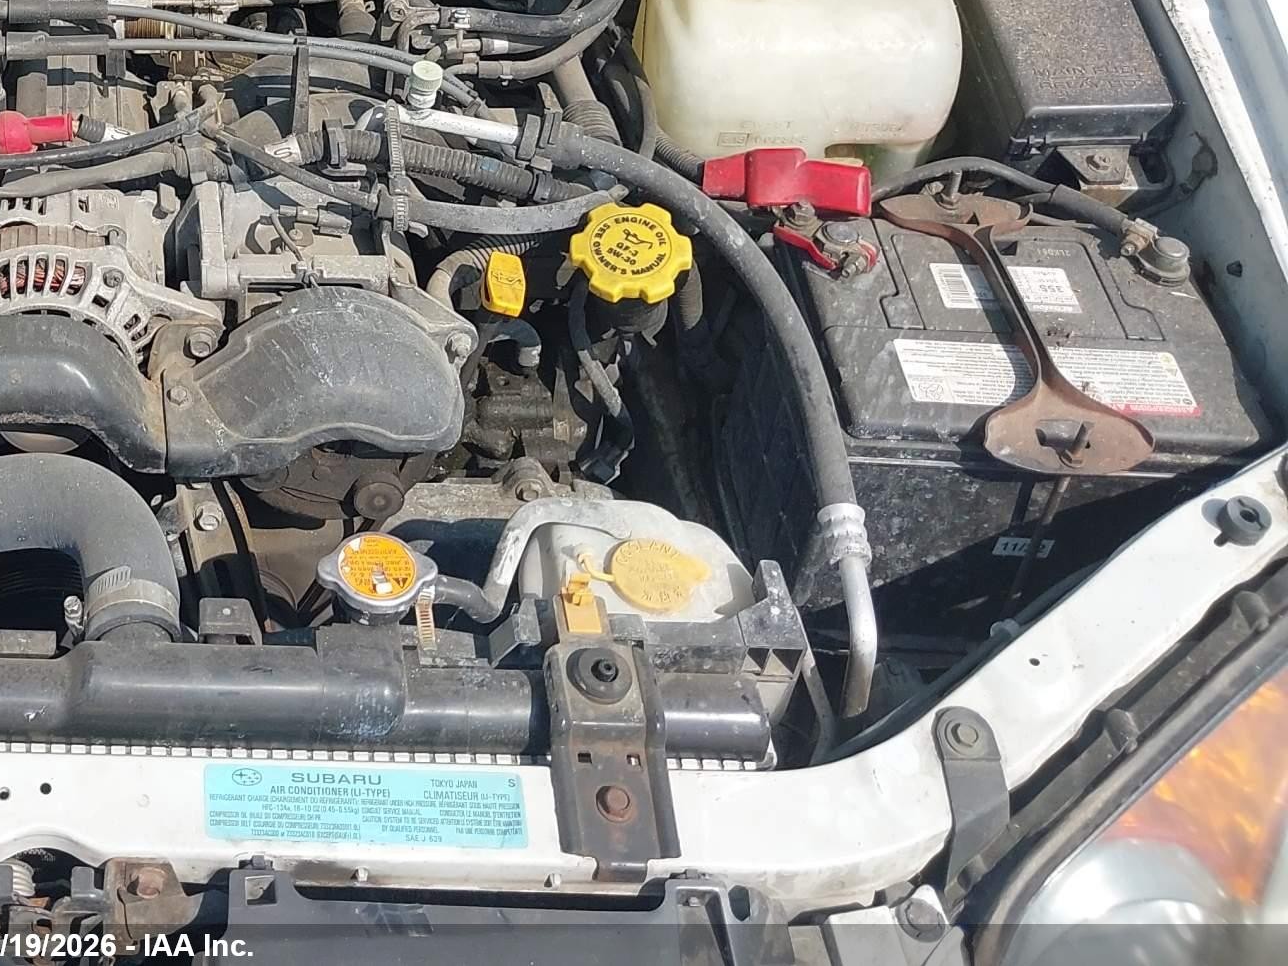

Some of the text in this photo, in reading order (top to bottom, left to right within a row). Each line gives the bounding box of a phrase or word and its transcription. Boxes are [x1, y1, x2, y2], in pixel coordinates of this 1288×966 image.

[614, 216, 667, 246] ENGINE OIL
[593, 222, 666, 276] SEE OWNER'S MANUAL
[616, 242, 639, 257] GF-3
[607, 247, 637, 265] 5W-30
[291, 772, 382, 785] SUBARU
[430, 779, 478, 789] TOKYO JAPAN
[507, 778, 516, 788] S
[270, 785, 286, 795] AIR
[288, 786, 349, 797] CONDITIONER
[423, 791, 479, 801] CLIMATISEUR
